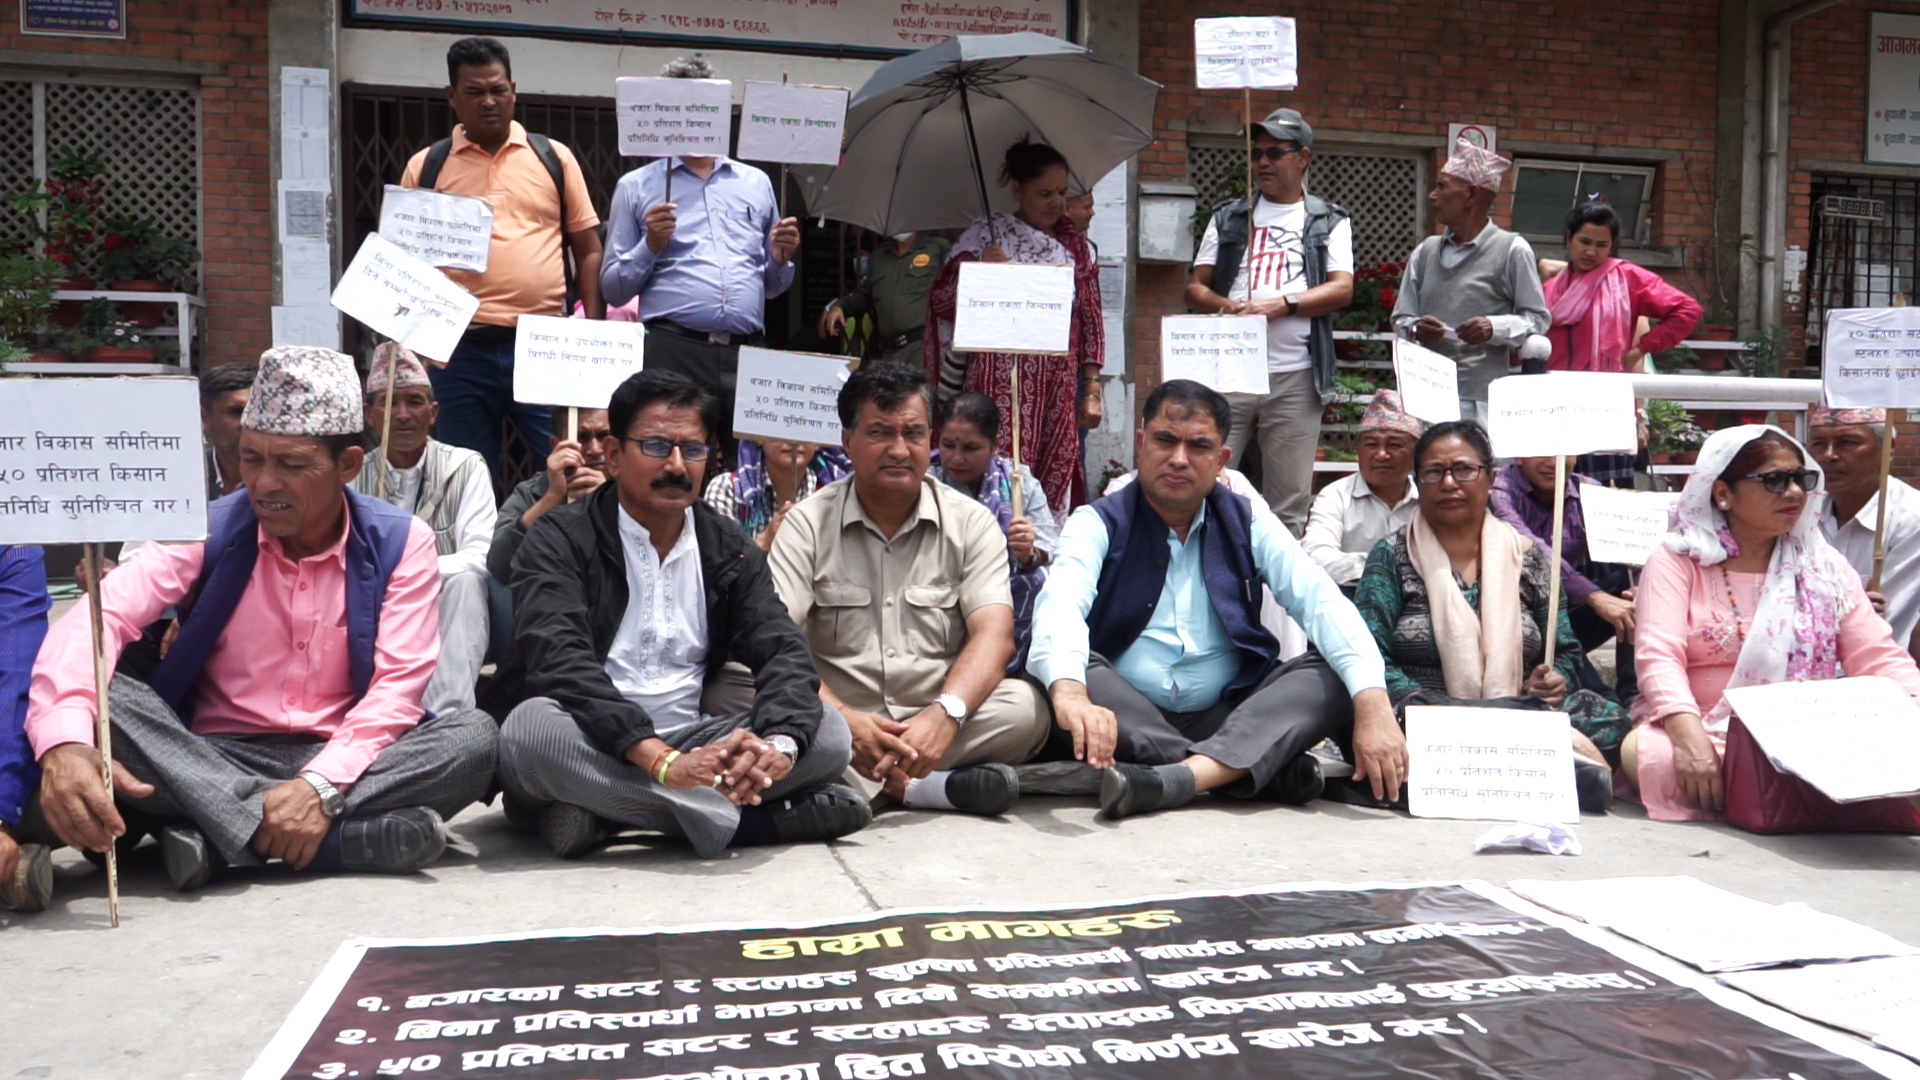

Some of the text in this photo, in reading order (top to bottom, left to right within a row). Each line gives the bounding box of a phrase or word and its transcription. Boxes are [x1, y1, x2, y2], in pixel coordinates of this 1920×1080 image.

[969, 297, 995, 309] किसान
[36, 430, 95, 451] विकास
[104, 430, 182, 451] समितिमा
[36, 462, 101, 483] प्रतिशत
[110, 462, 168, 482] किसान
[60, 494, 144, 521] सुनिश्चित
[152, 499, 177, 514] गर
[1460, 742, 1498, 755] विकास
[1509, 764, 1547, 779] किसान
[740, 927, 903, 960] हाम्रा
[335, 1029, 377, 1045] २.
[395, 1019, 501, 1041] बिना
[513, 1003, 701, 1034] प्रतिस्पर्धा
[714, 996, 862, 1020] भाडामा
[1146, 965, 1273, 990] खारेज
[1273, 960, 1344, 977] गर
[404, 985, 565, 1009] बजारका
[574, 979, 664, 999] सटर
[673, 978, 703, 993] र
[376, 1055, 441, 1076] ५०
[462, 1043, 631, 1070] प्रतिशत
[643, 1033, 752, 1057] सटर
[764, 1029, 799, 1046] र
[999, 1004, 1175, 1034] उत्पादक
[1179, 983, 1406, 1017] किसानलाई
[937, 1042, 1087, 1069] विरोधी
[1093, 1033, 1240, 1063] निर्णय
[1241, 1021, 1385, 1051] खारेज
[1383, 1017, 1465, 1036] गर
